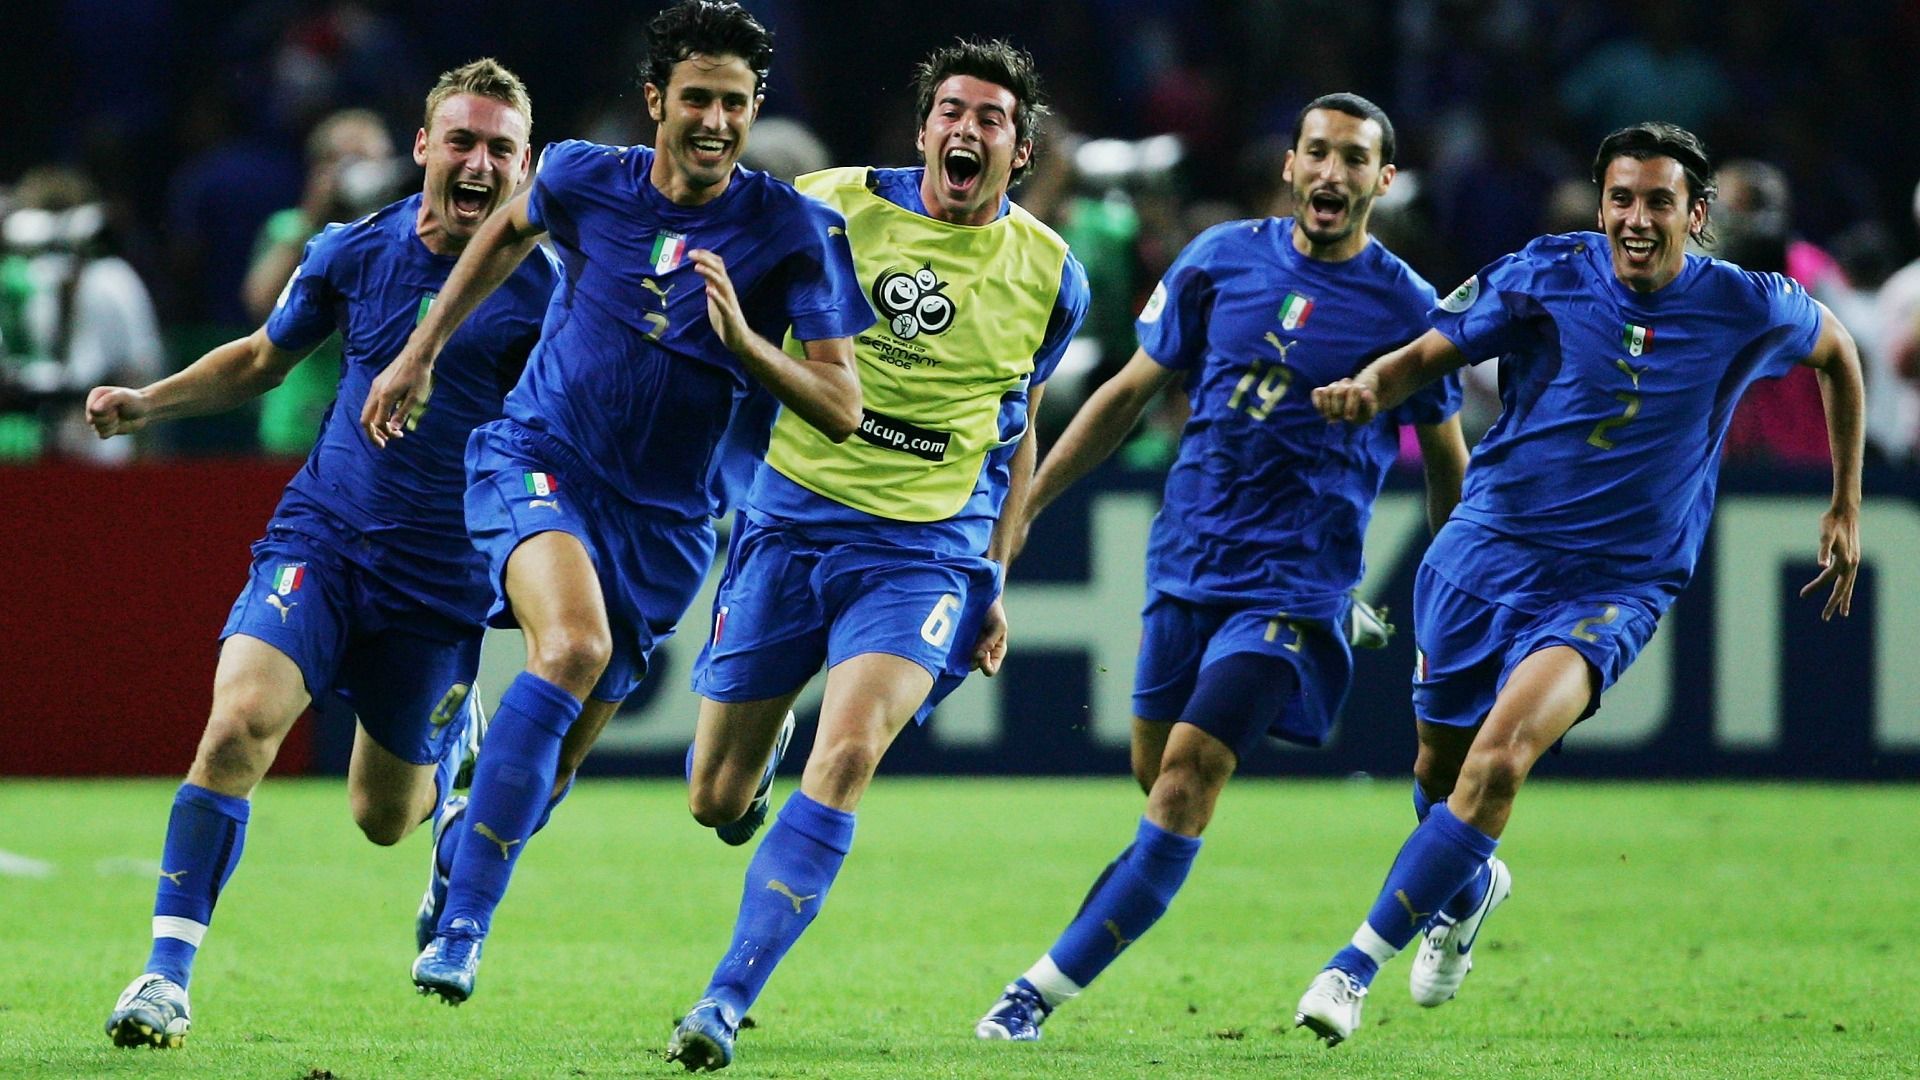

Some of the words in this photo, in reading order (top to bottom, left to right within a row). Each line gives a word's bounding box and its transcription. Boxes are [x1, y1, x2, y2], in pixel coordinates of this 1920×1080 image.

[859, 335, 942, 368] GERMANY
[878, 354, 913, 370] 2006
[914, 345, 926, 353] CUP
[1226, 358, 1293, 422] 19
[1586, 392, 1643, 450] 2
[920, 592, 961, 648] 6
[1570, 602, 1620, 643] 2
